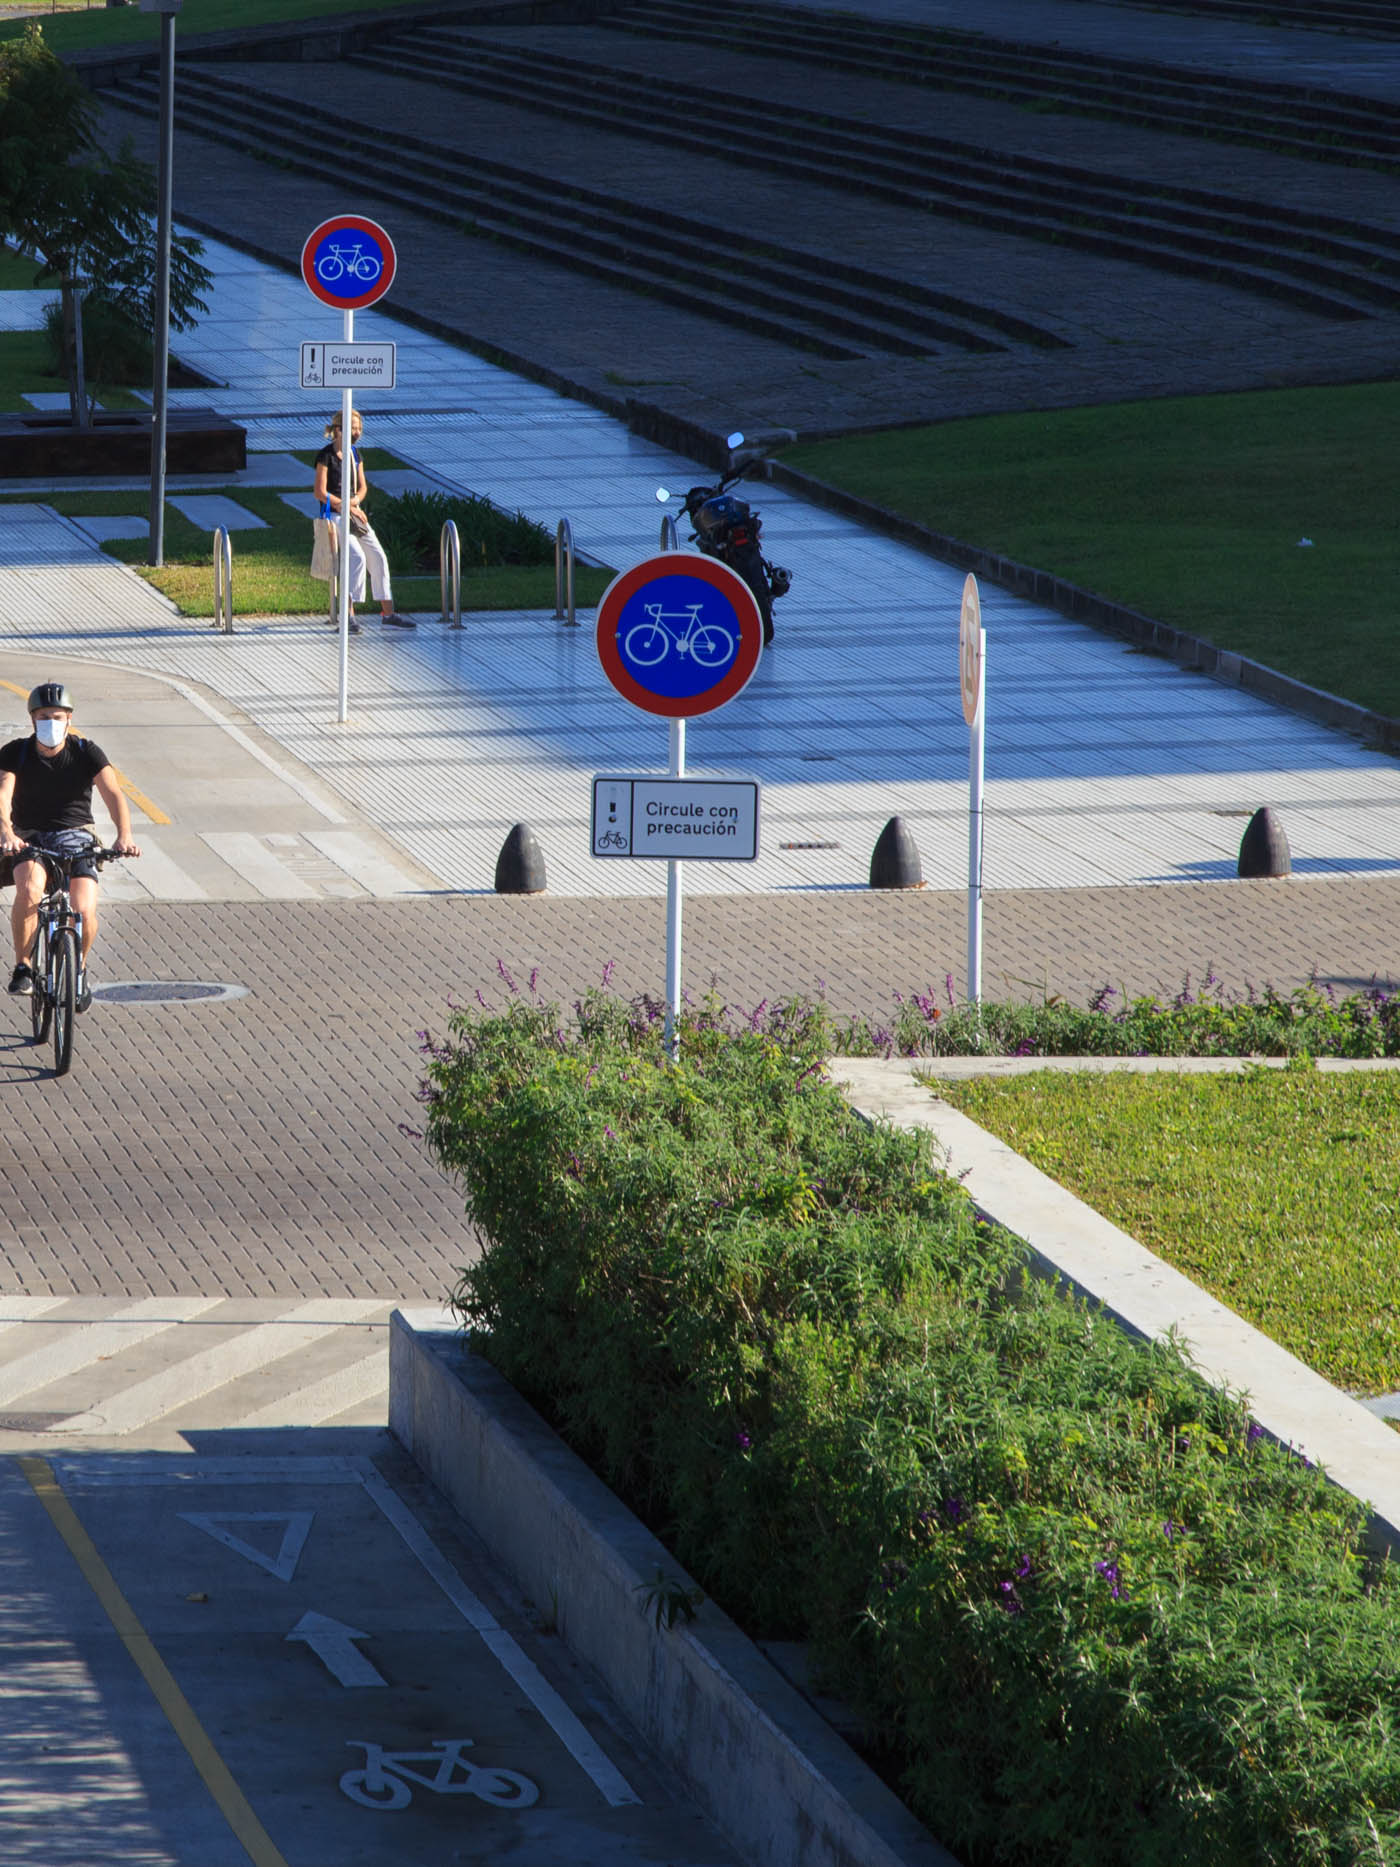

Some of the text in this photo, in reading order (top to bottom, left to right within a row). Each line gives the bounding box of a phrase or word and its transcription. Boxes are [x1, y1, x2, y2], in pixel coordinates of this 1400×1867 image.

[331, 356, 384, 365] Circule con
[332, 365, 383, 375] precaución
[646, 801, 739, 818] Circule con
[647, 819, 737, 837] precaución
